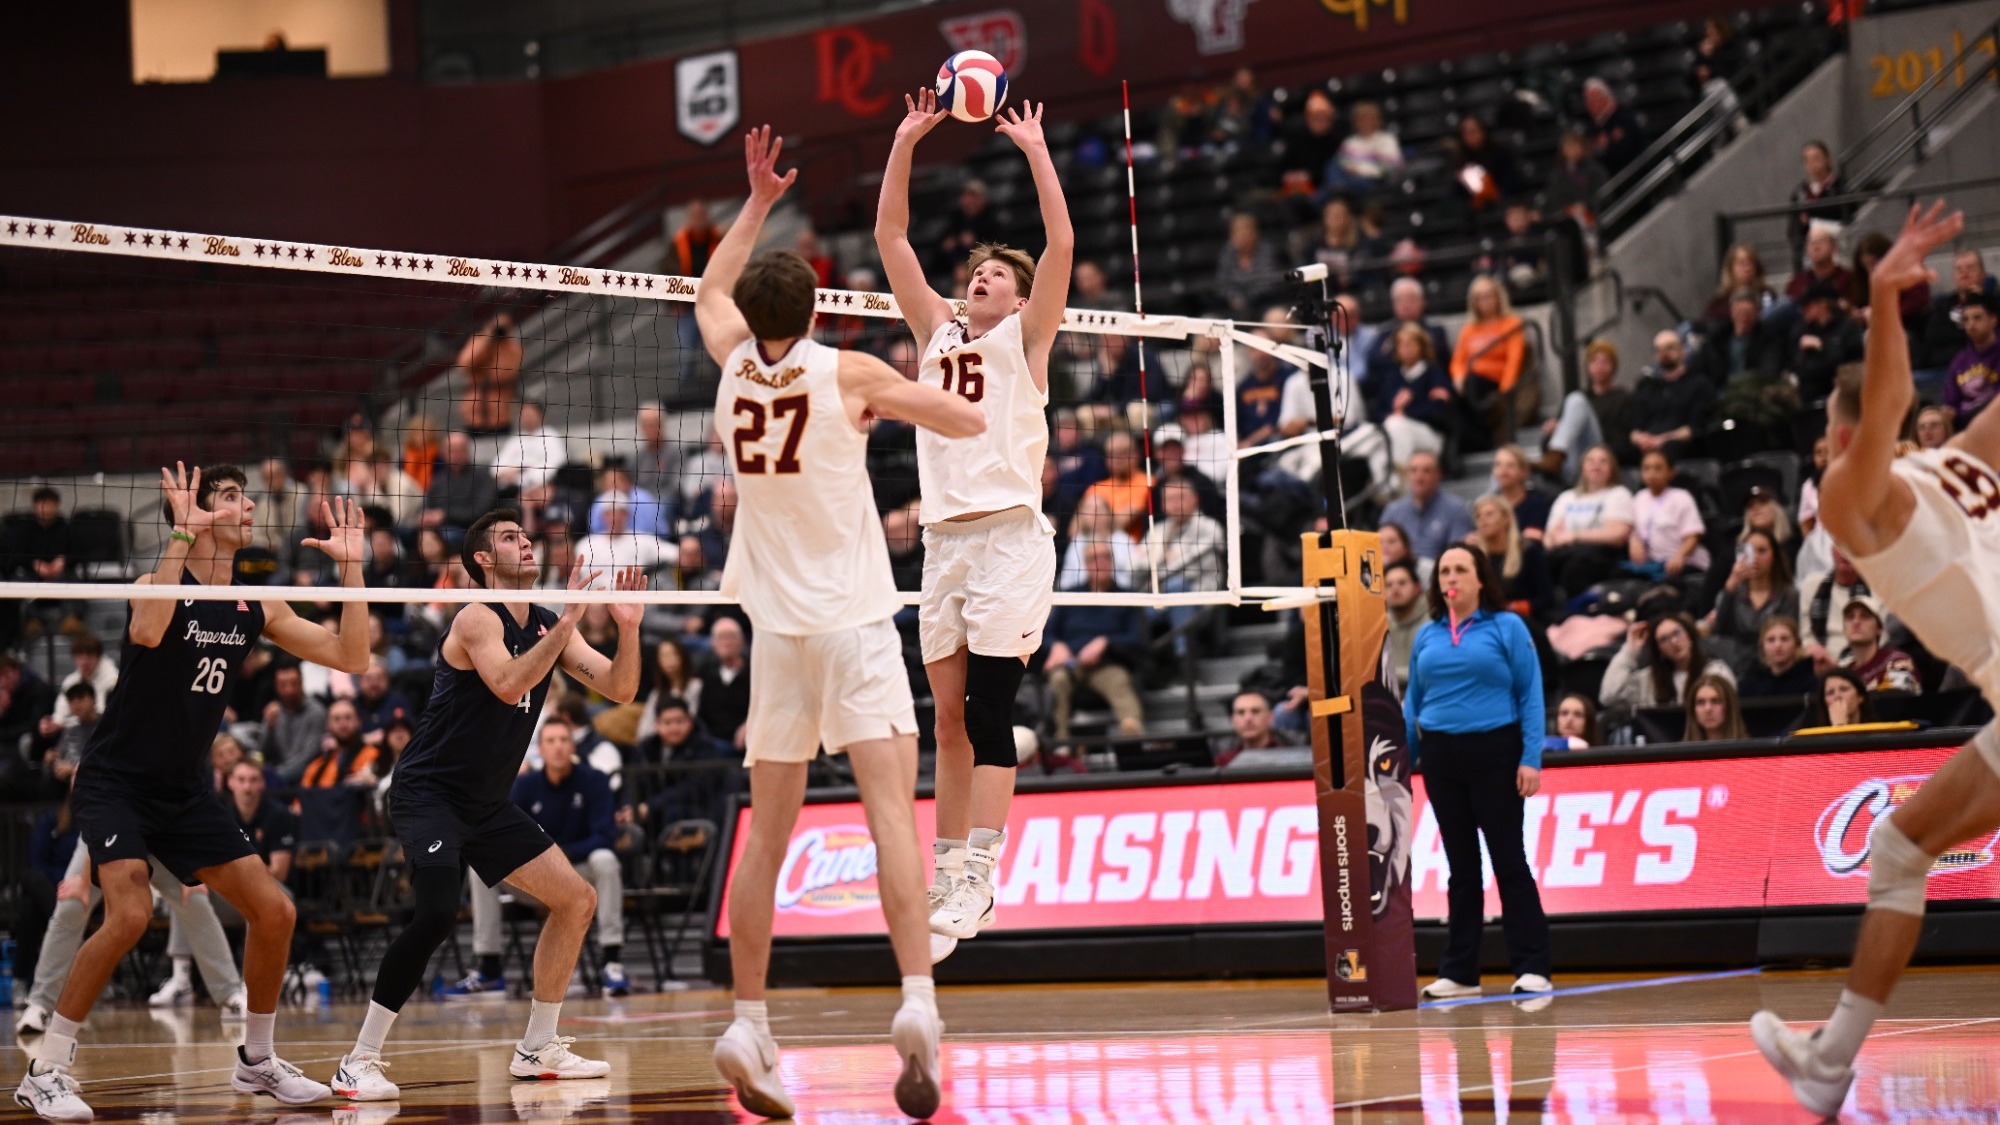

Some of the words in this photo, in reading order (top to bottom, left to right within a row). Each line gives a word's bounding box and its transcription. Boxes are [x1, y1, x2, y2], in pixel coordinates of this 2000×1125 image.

[939, 352, 985, 403] 16
[732, 393, 809, 475] 27
[183, 619, 247, 648] Pepperde
[190, 656, 228, 694] 26
[993, 805, 1318, 905] AISING
[1333, 814, 1350, 867] sports
[1337, 868, 1354, 932] imports
